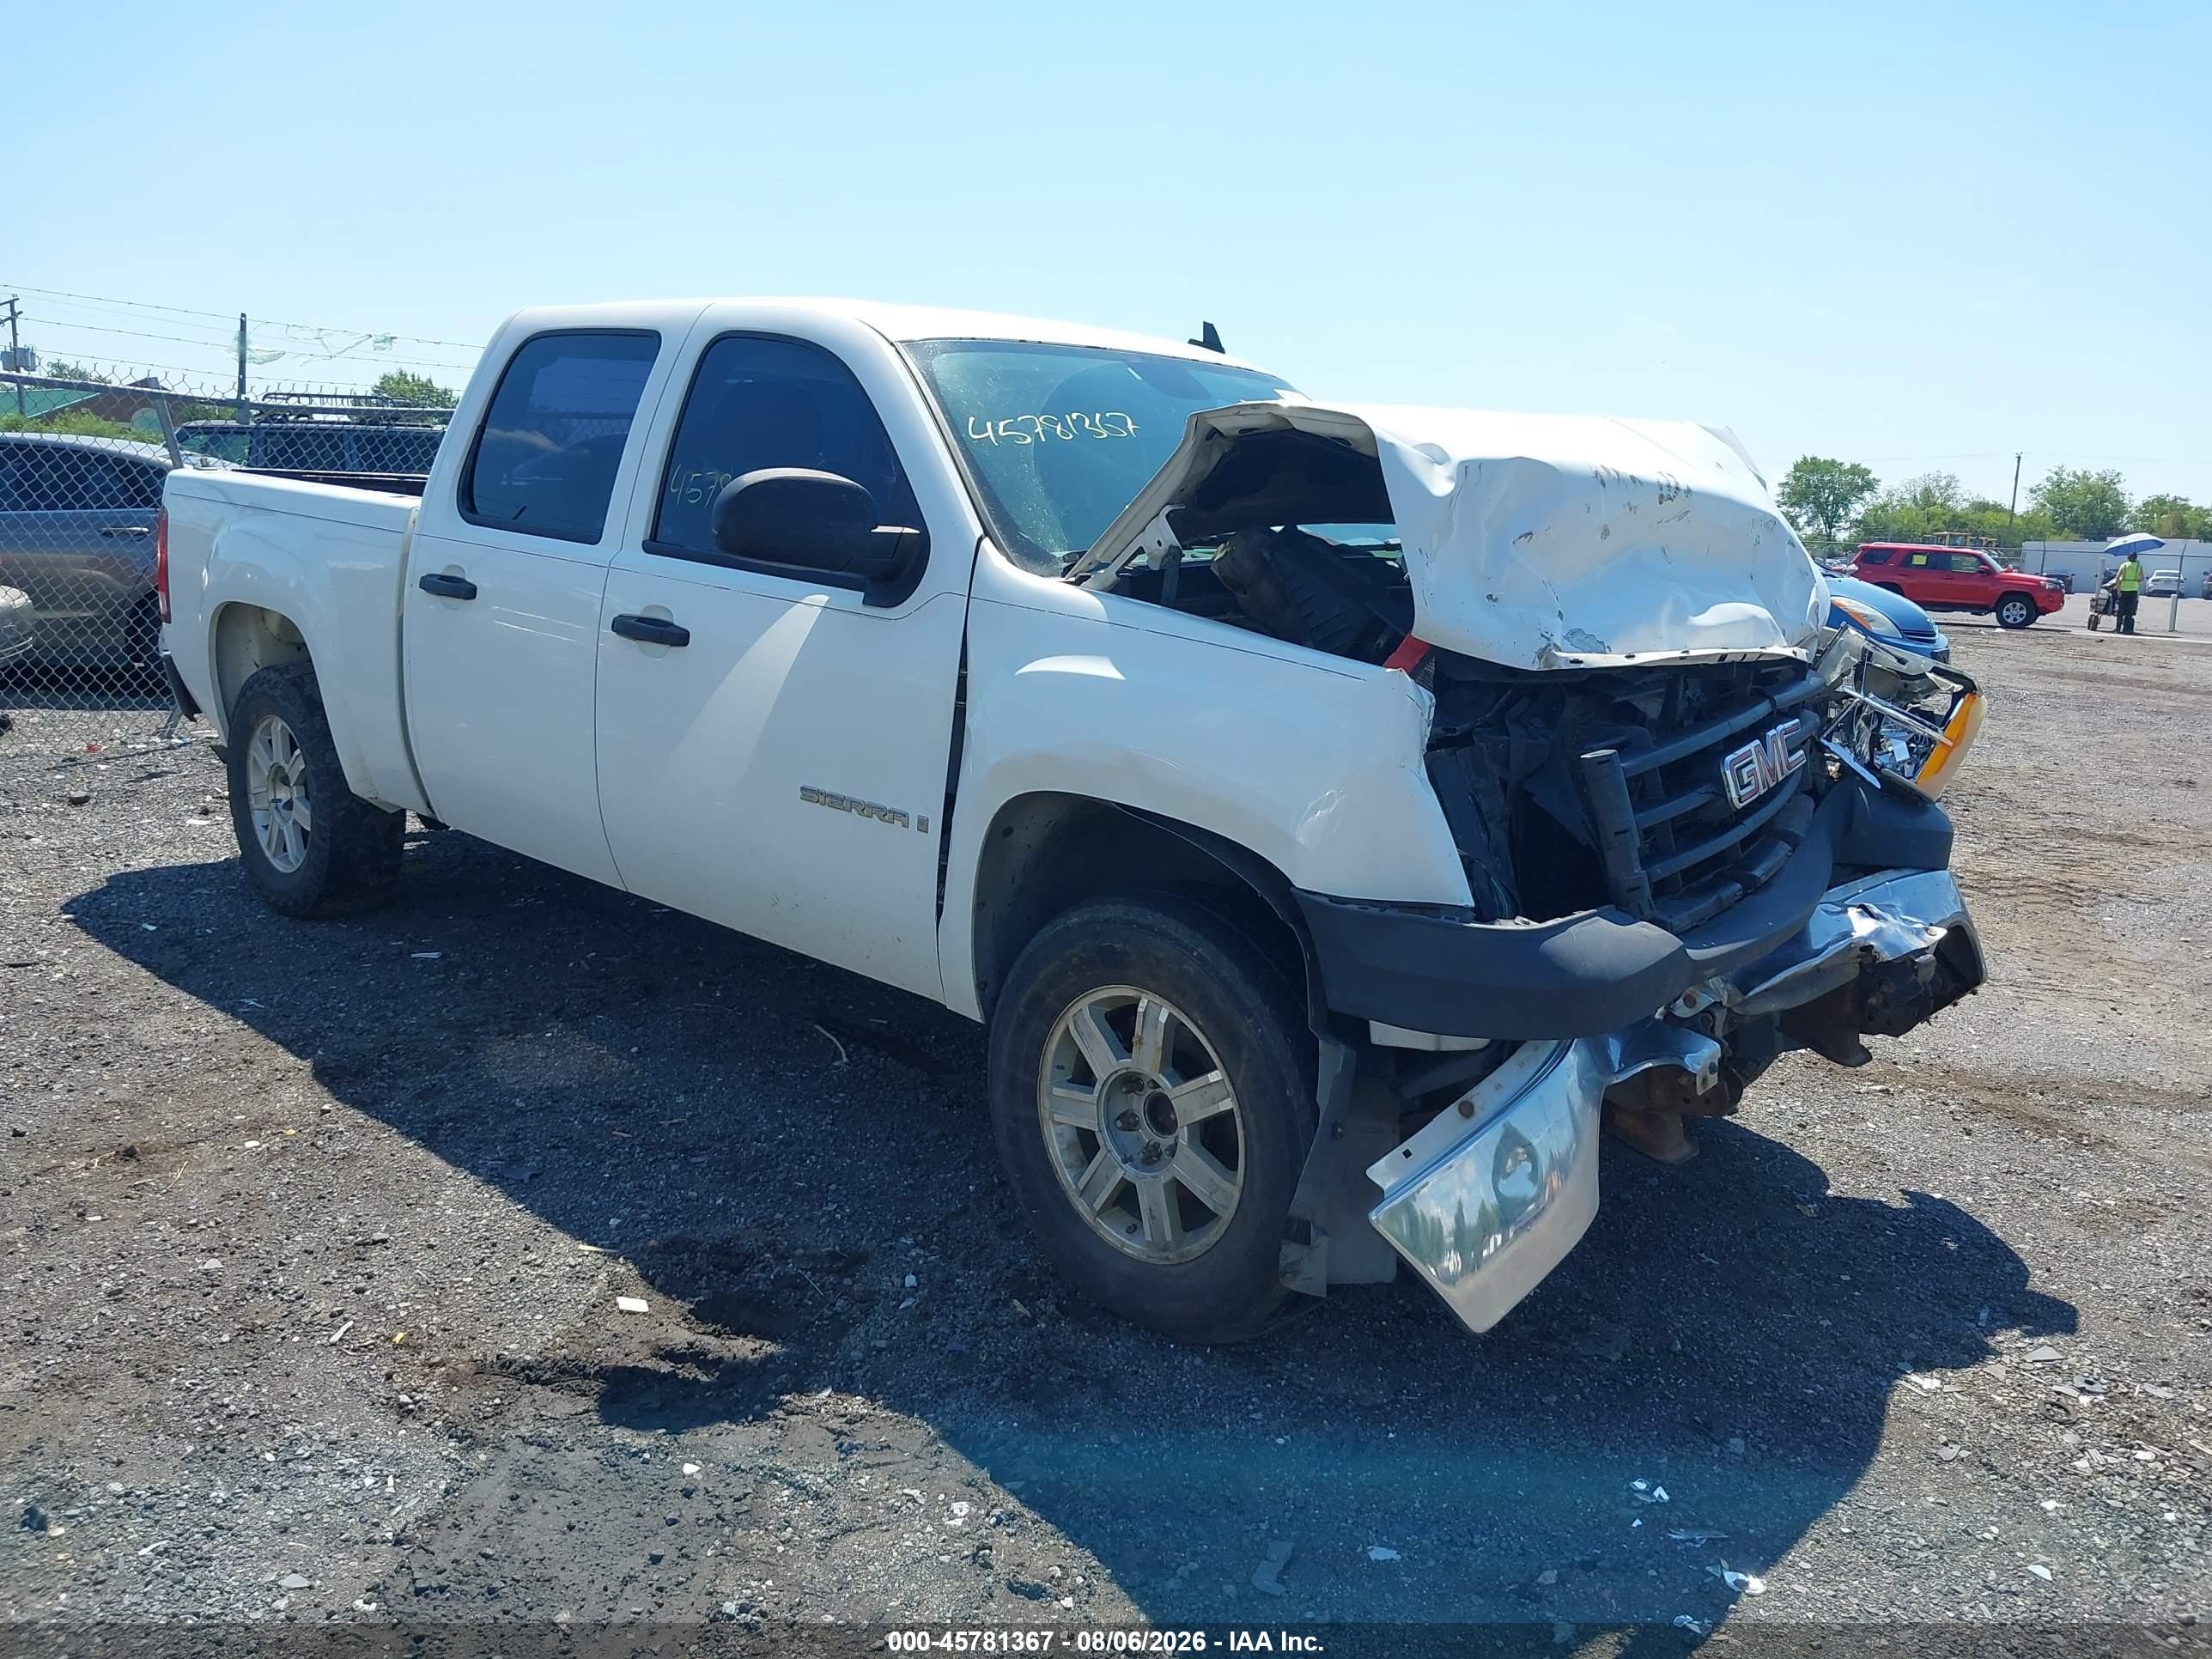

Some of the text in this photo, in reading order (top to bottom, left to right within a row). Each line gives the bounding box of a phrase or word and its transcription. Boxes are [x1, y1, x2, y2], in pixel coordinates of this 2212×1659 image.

[968, 411, 1140, 447] 45781367
[1723, 718, 1807, 809] GMC
[799, 784, 909, 829] SIERRA
